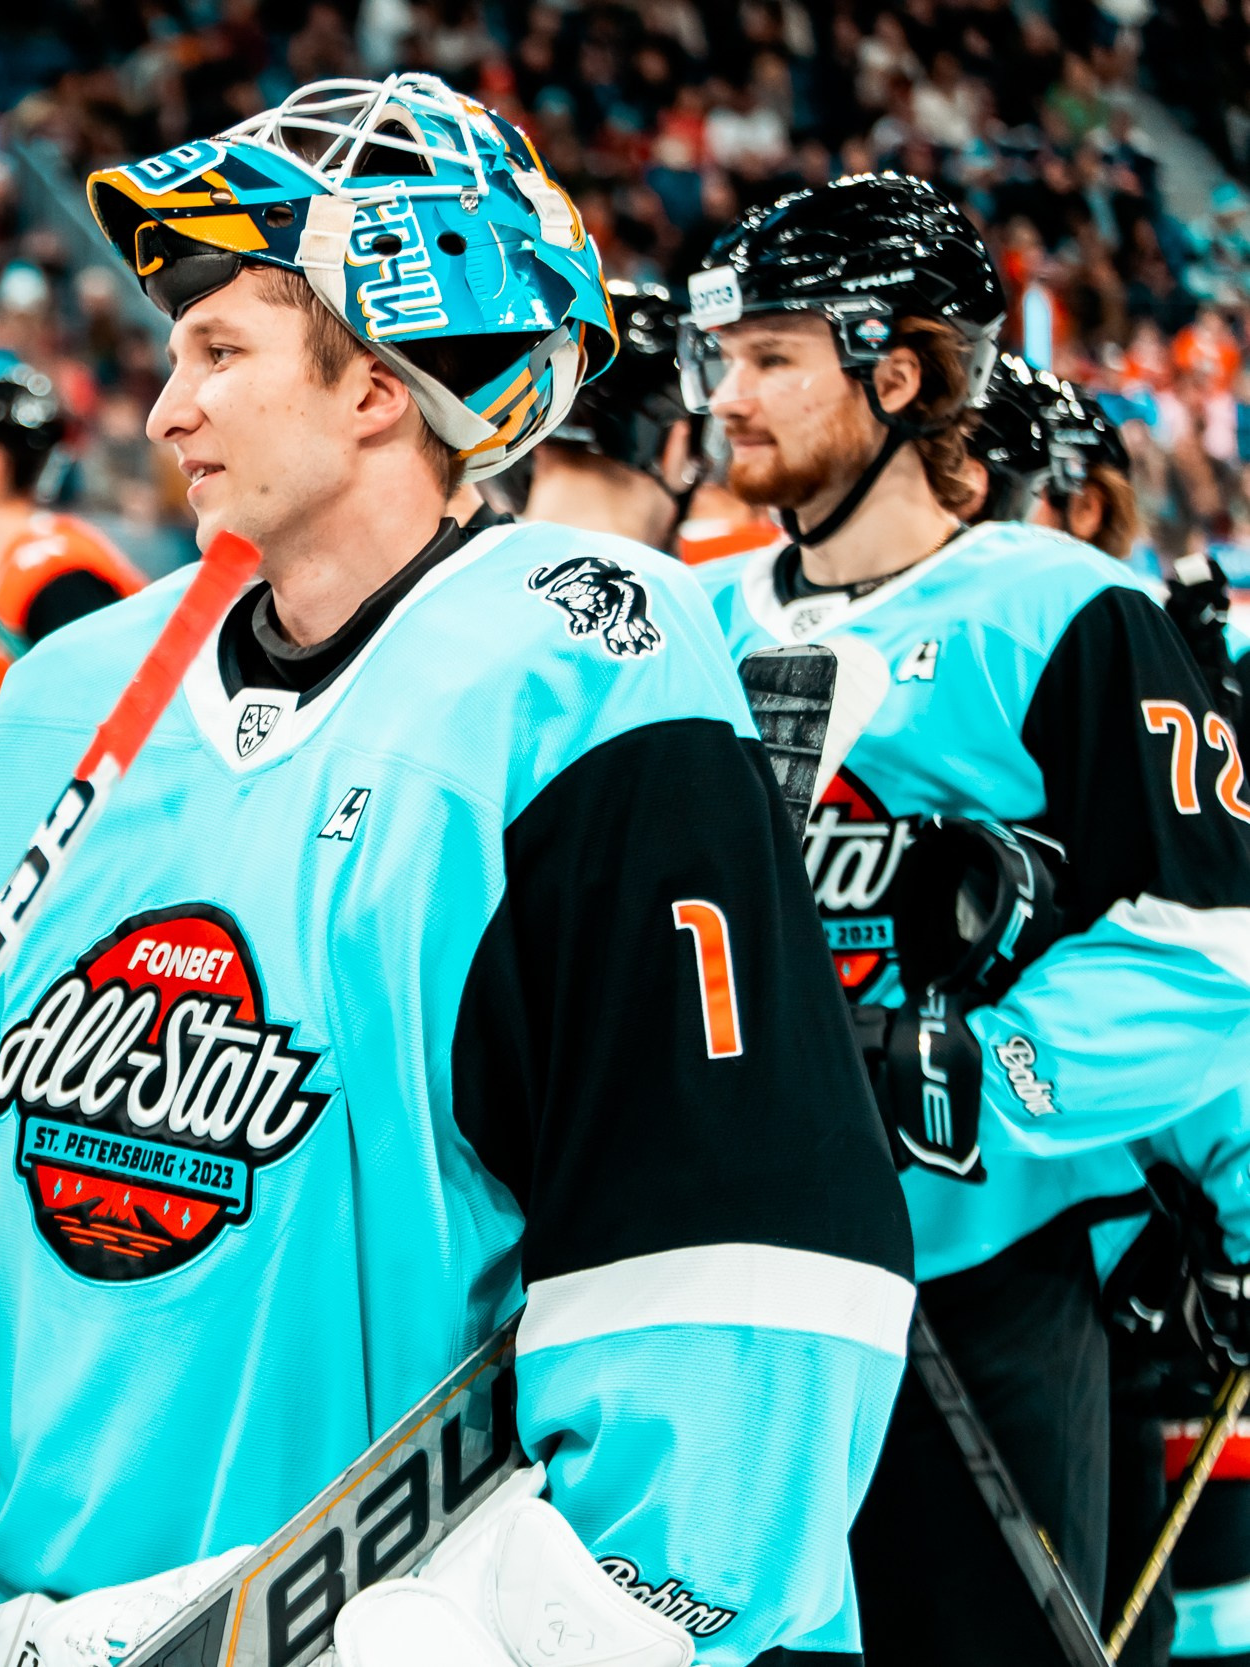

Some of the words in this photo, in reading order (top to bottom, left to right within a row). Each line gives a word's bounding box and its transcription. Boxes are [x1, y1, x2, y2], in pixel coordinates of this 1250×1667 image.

[1141, 700, 1250, 824] 72
[127, 938, 234, 985] FONBET
[671, 899, 744, 1060] 1
[64, 1132, 175, 1179] PETERSBURG
[186, 1158, 234, 1191] 2023
